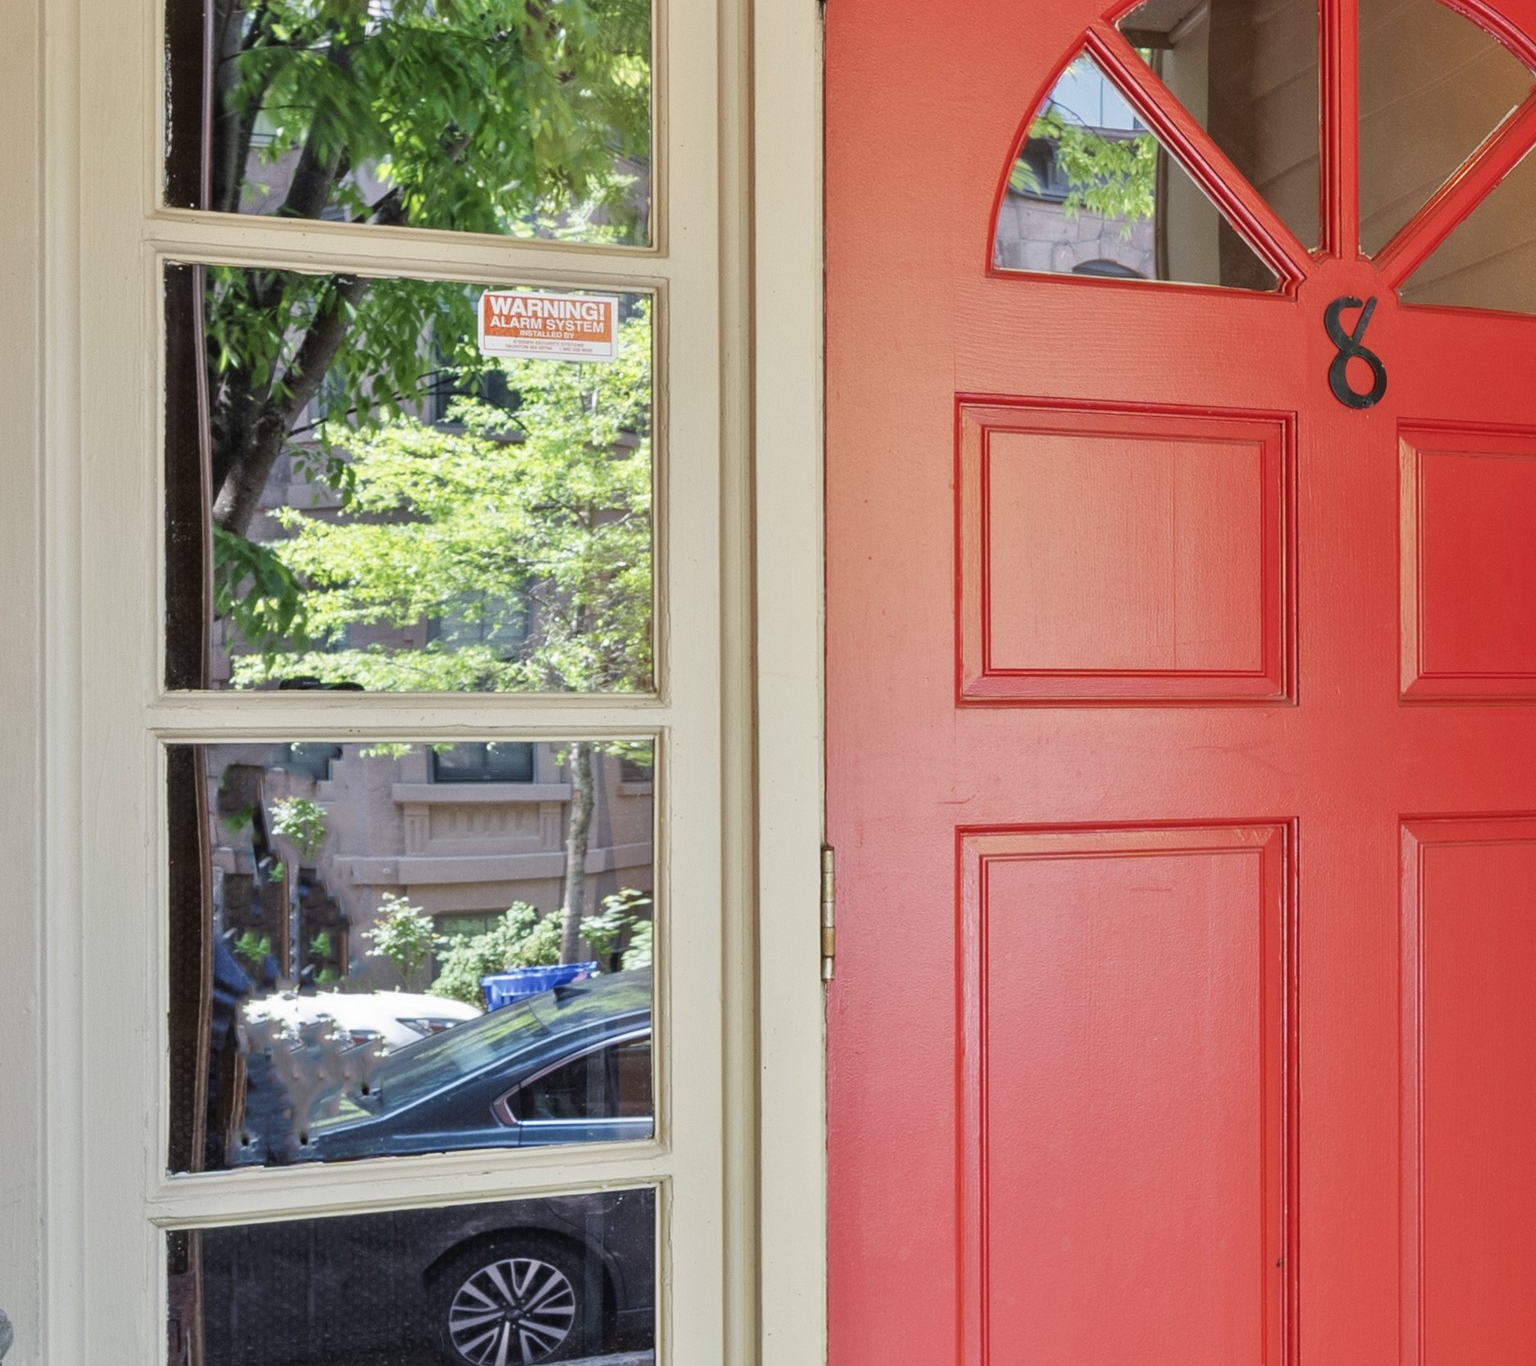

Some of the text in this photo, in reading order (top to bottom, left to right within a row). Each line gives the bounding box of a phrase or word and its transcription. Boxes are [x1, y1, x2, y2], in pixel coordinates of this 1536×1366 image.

[489, 296, 605, 321] WARNING!
[490, 316, 604, 333] ALARM SYSTEM
[520, 330, 562, 339] INSTALLED
[1323, 296, 1387, 410] 8
